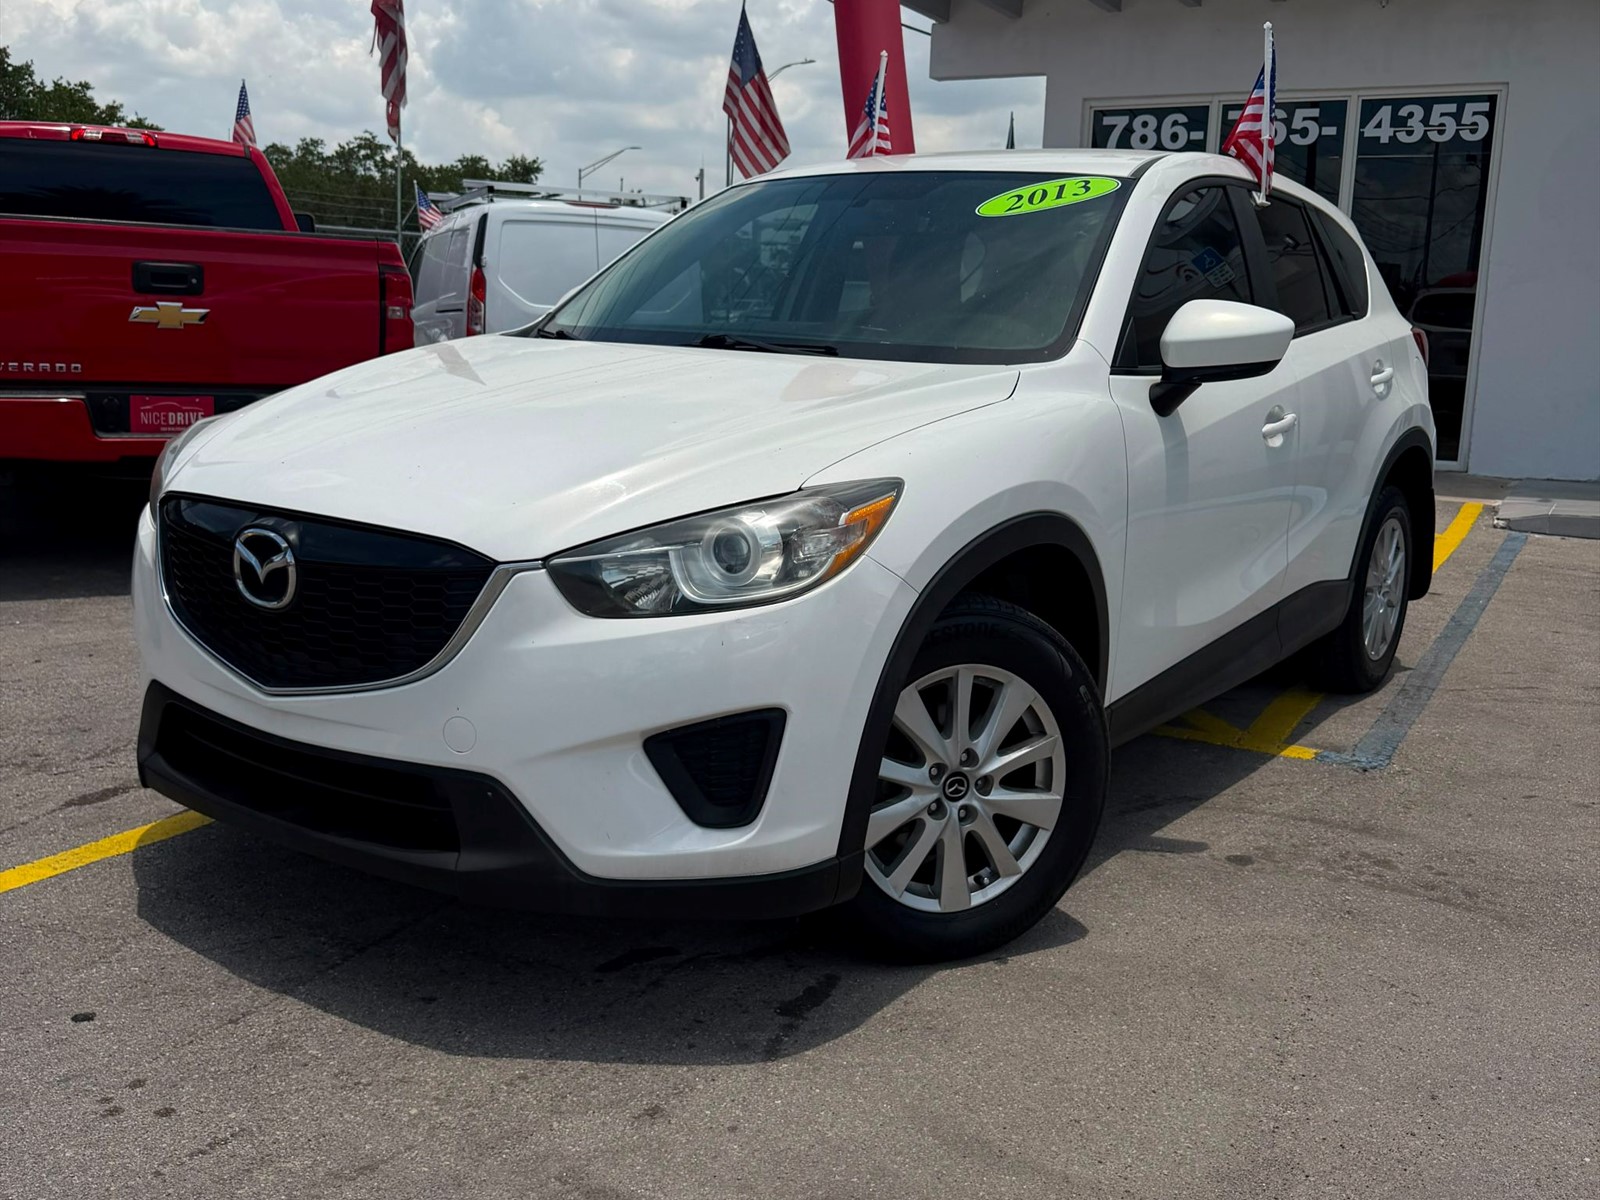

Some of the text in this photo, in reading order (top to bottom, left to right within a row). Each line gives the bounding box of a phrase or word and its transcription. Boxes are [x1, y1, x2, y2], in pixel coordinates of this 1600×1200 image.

[1102, 102, 1490, 150] 786- 65- 4355
[1004, 180, 1091, 212] 2013
